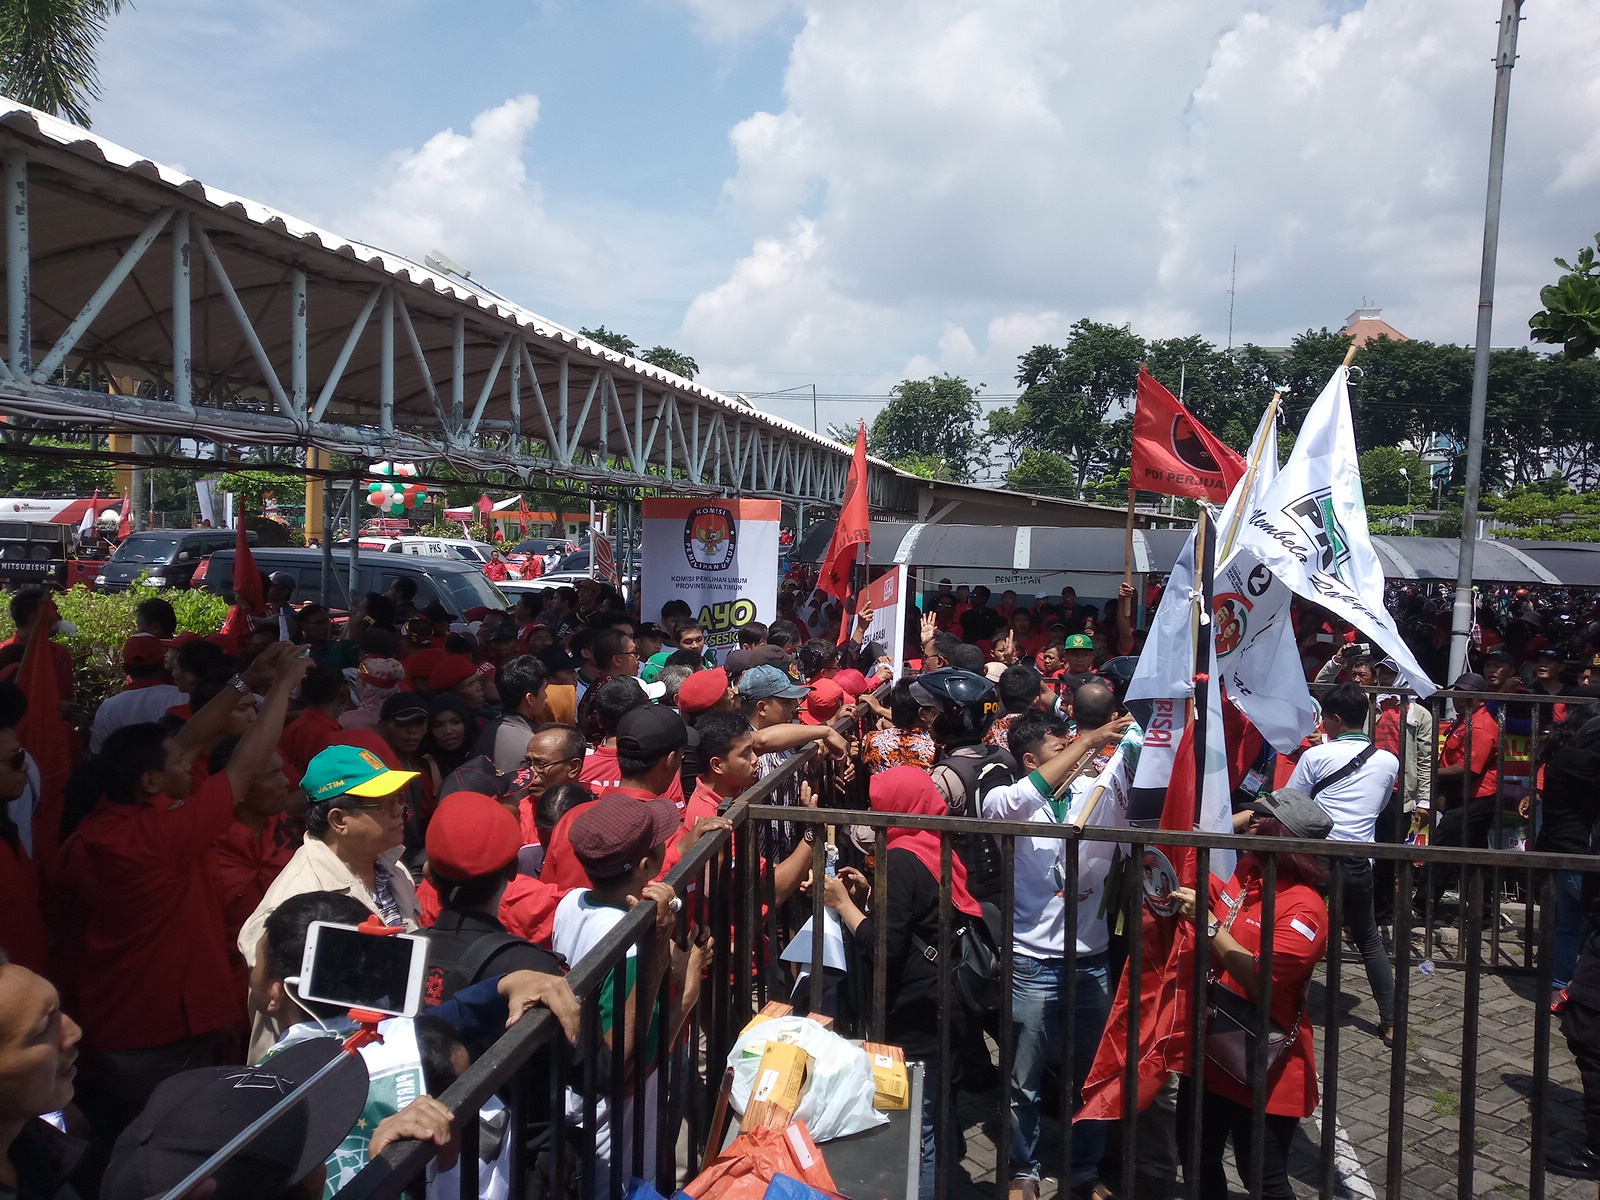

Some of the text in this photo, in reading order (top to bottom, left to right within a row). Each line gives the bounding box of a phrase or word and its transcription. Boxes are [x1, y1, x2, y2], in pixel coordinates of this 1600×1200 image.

[1145, 469, 1225, 490] PDI PERJUA
[696, 507, 726, 516] KOMISI
[1248, 508, 1308, 566] Membela
[429, 543, 441, 553] PKS
[685, 542, 735, 570] PEMILIHAN UMUM
[1, 562, 49, 571] MITSUBISHI
[995, 575, 1041, 585] PENITIPAN
[1249, 567, 1270, 594] 2
[698, 599, 755, 631] AYO
[704, 631, 740, 647] KSESK
[983, 702, 1000, 715] PO
[1143, 697, 1174, 748] RISAI
[318, 779, 346, 794] JATIM
